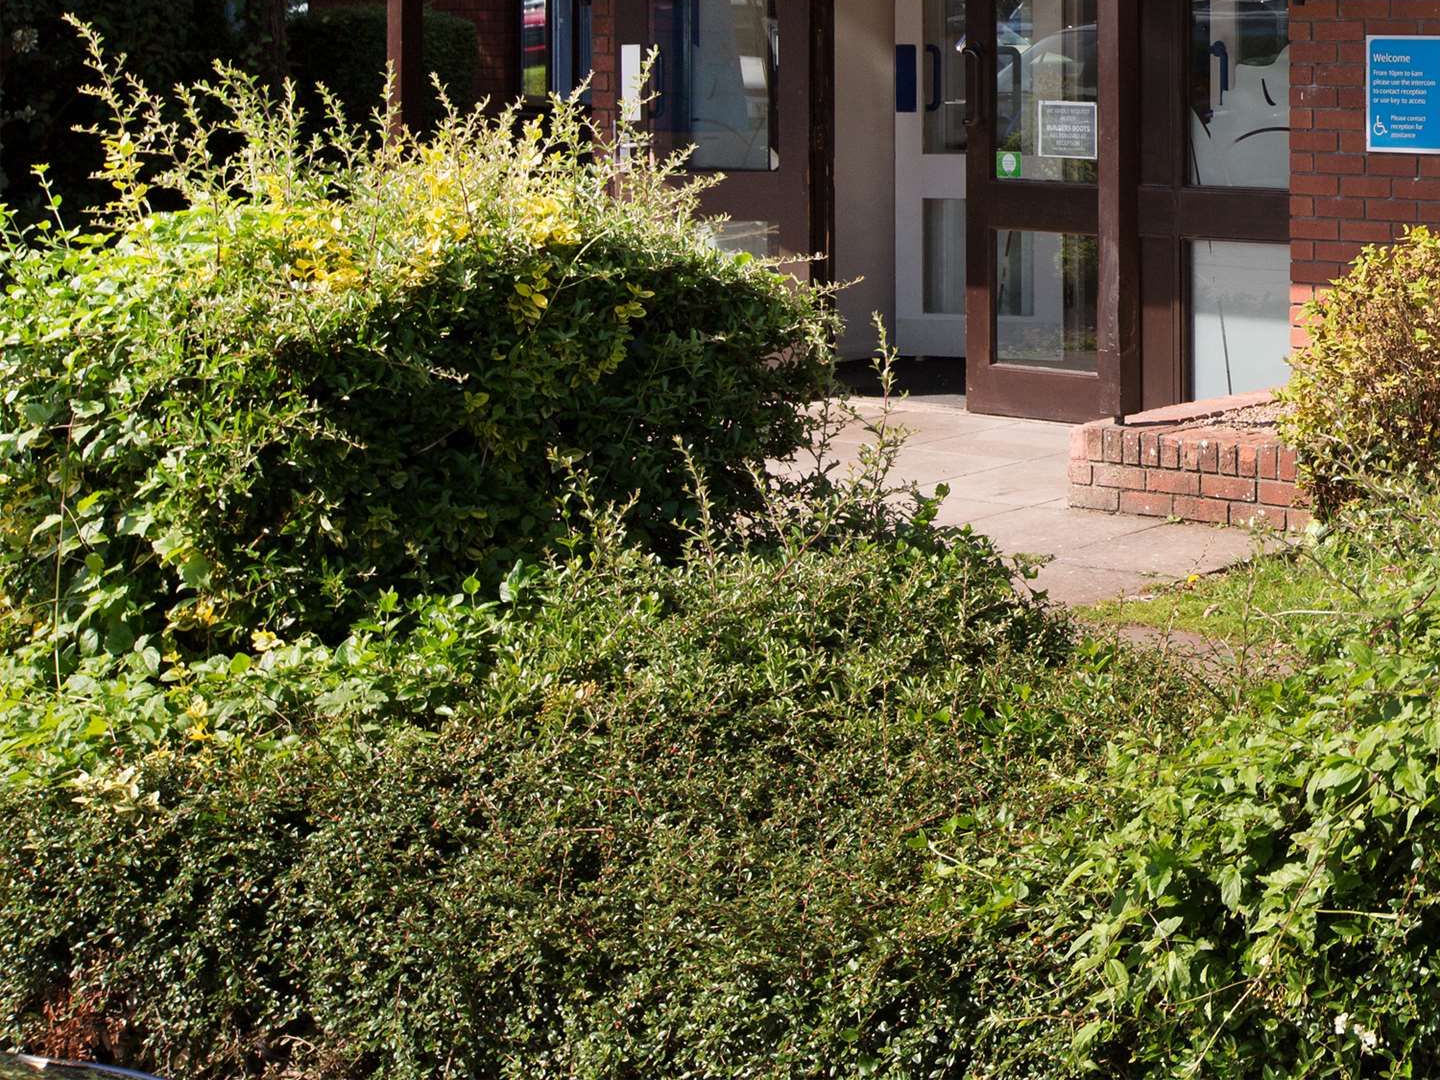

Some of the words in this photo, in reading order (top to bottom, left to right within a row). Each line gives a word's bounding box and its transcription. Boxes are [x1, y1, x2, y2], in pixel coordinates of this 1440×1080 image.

[1373, 52, 1411, 63] Welcome
[1373, 78, 1390, 86] please
[1411, 79, 1436, 87] intercom
[1401, 88, 1427, 96] reception
[1391, 96, 1400, 105] key
